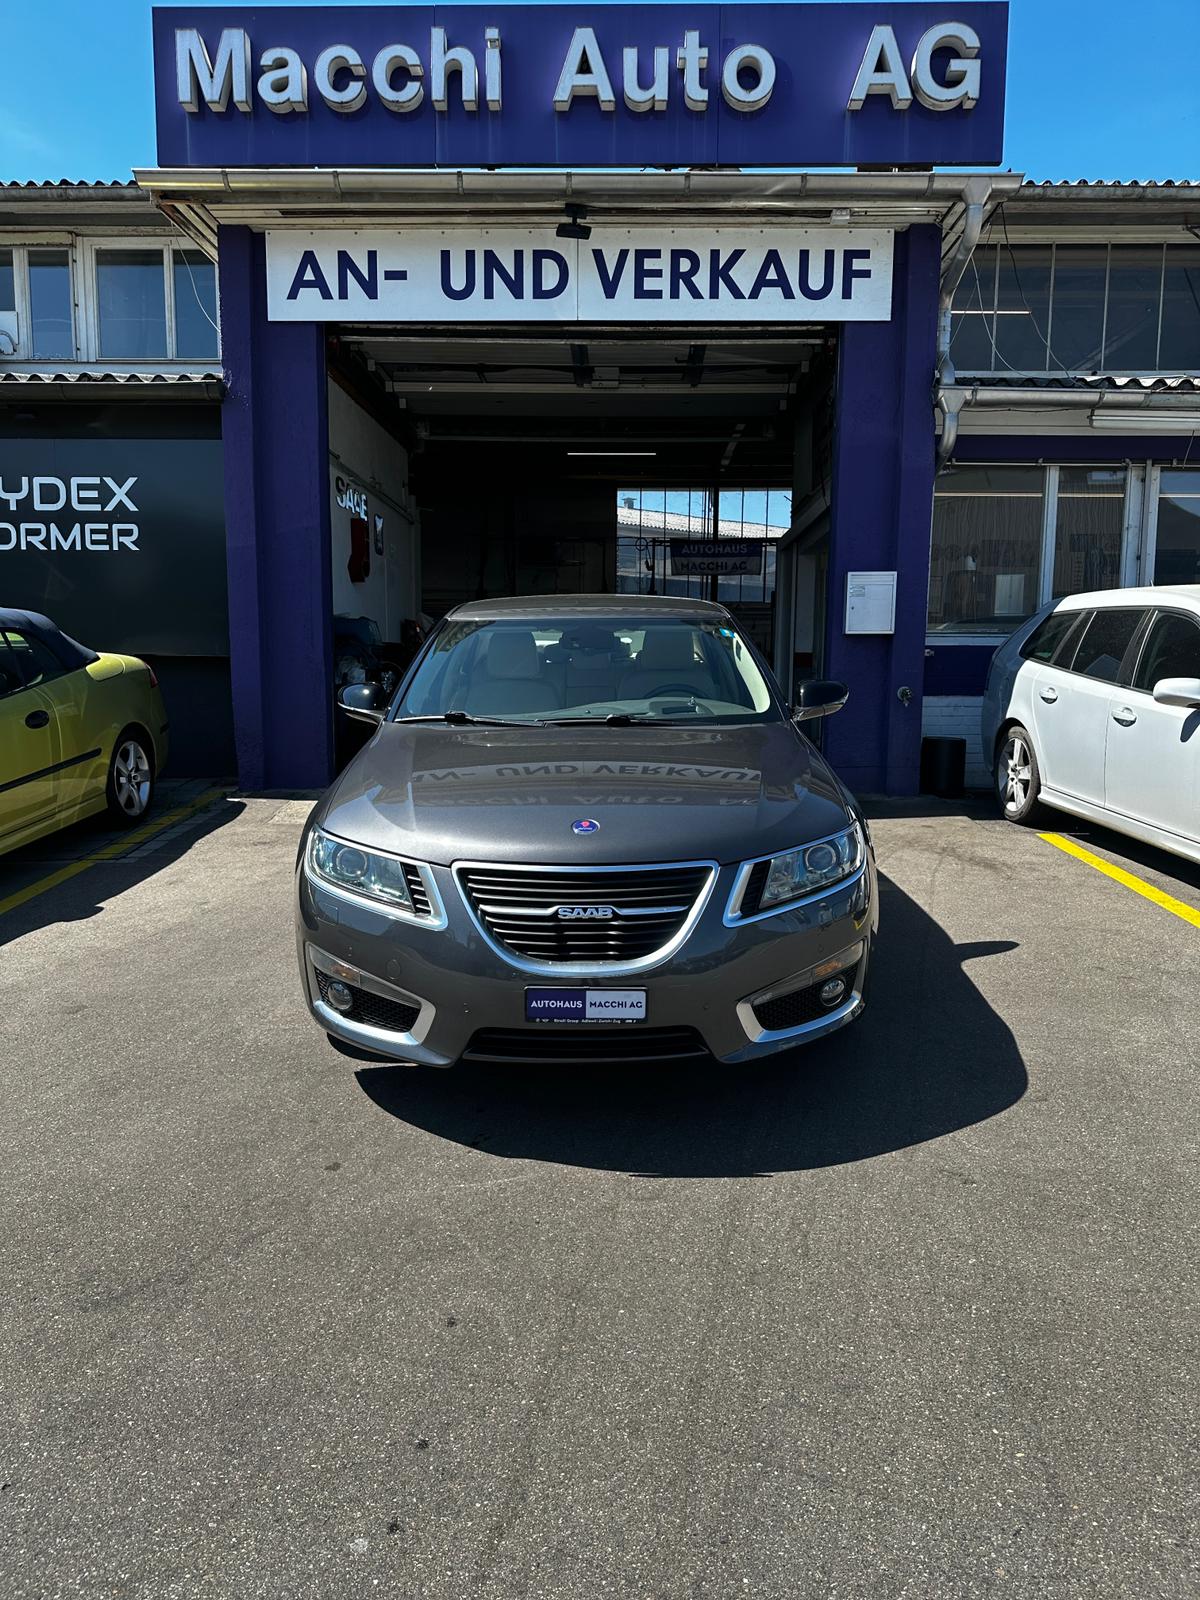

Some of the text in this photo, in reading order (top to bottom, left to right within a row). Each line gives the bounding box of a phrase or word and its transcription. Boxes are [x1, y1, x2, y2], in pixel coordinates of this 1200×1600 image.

[174, 22, 981, 114] Macchi Auto AG
[286, 248, 872, 300] AN- UND VERKAUF
[0, 476, 139, 511] YDEX
[681, 544, 748, 554] AUTOHAUS
[680, 561, 728, 572] MACCHI
[558, 907, 613, 919] SAAB
[530, 1000, 643, 1009] AUTOHAUS MACCHI AG
